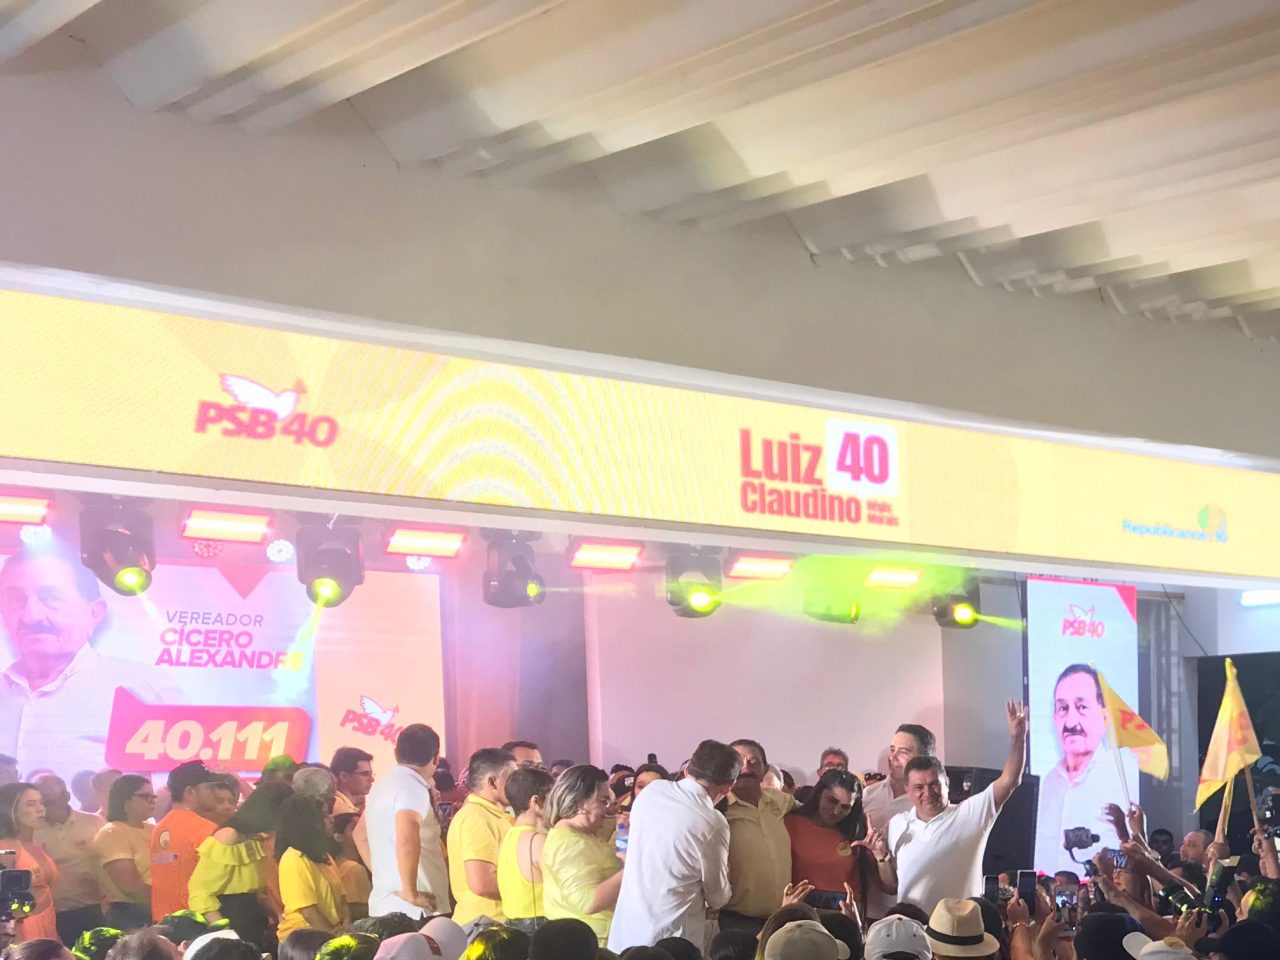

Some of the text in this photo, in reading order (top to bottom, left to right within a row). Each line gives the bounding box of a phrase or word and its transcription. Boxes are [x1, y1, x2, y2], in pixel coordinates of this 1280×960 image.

[195, 400, 339, 448] PSB 40
[739, 428, 889, 486] Luiz 40
[740, 480, 862, 523] Claudino
[159, 622, 254, 649] CÍCERO
[166, 610, 264, 627] VEREADOR
[1062, 618, 1105, 638] PSB 40
[155, 647, 304, 671] ALEXANDRE
[125, 719, 289, 761] 40.111
